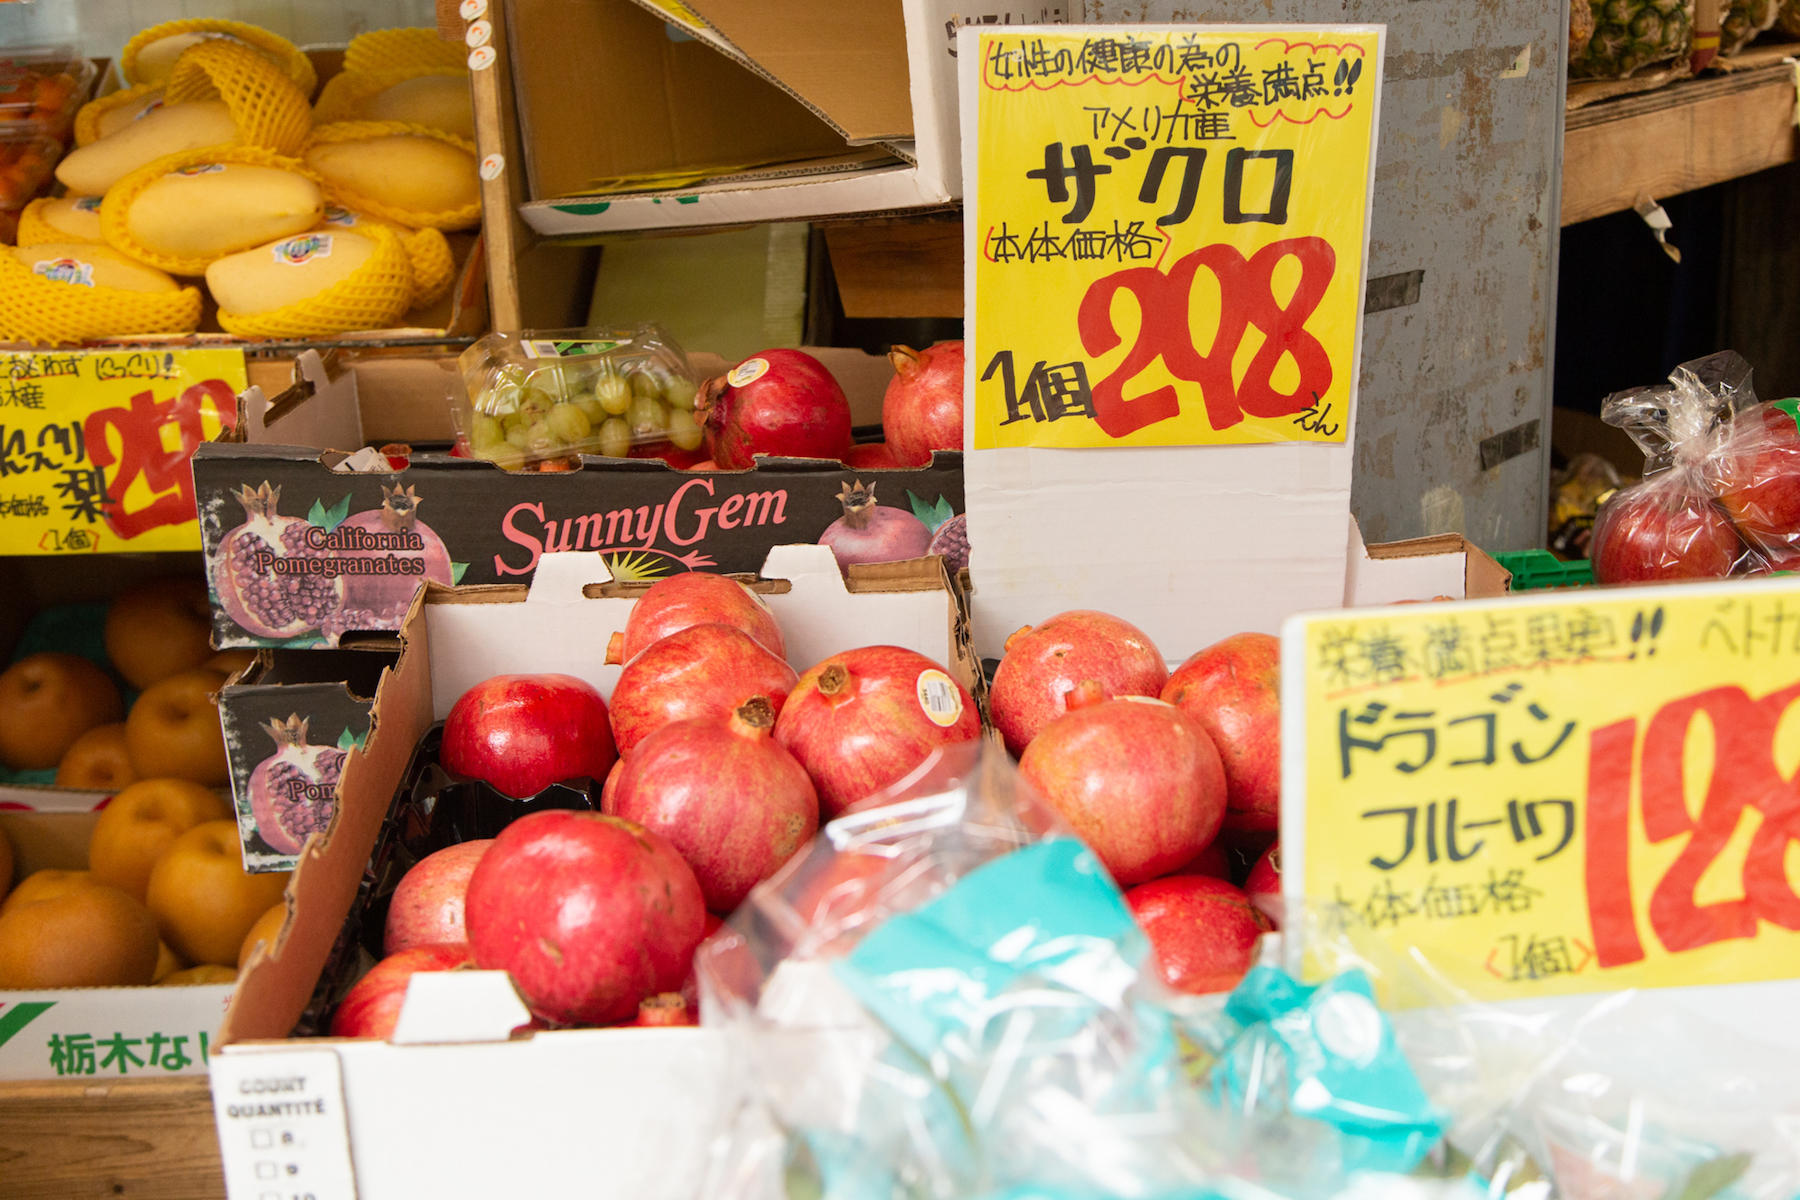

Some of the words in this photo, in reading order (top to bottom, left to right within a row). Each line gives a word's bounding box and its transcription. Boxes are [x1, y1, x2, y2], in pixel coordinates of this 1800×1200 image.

[1083, 101, 1237, 143] アメリカ産
[1026, 137, 1295, 226] ザクロ
[981, 350, 1098, 427] 1個
[1077, 235, 1337, 439] 298
[0, 382, 46, 410] 木産
[305, 526, 425, 551] California
[495, 478, 788, 576] SunnyGem
[255, 552, 426, 578] Pomegranates
[1698, 599, 1800, 660] ベトナ
[1338, 682, 1578, 780] ドラゴン
[1360, 798, 1577, 870] フルーツ
[227, 1099, 326, 1118] QUANTITÉ
[239, 1076, 307, 1094] COUNT
